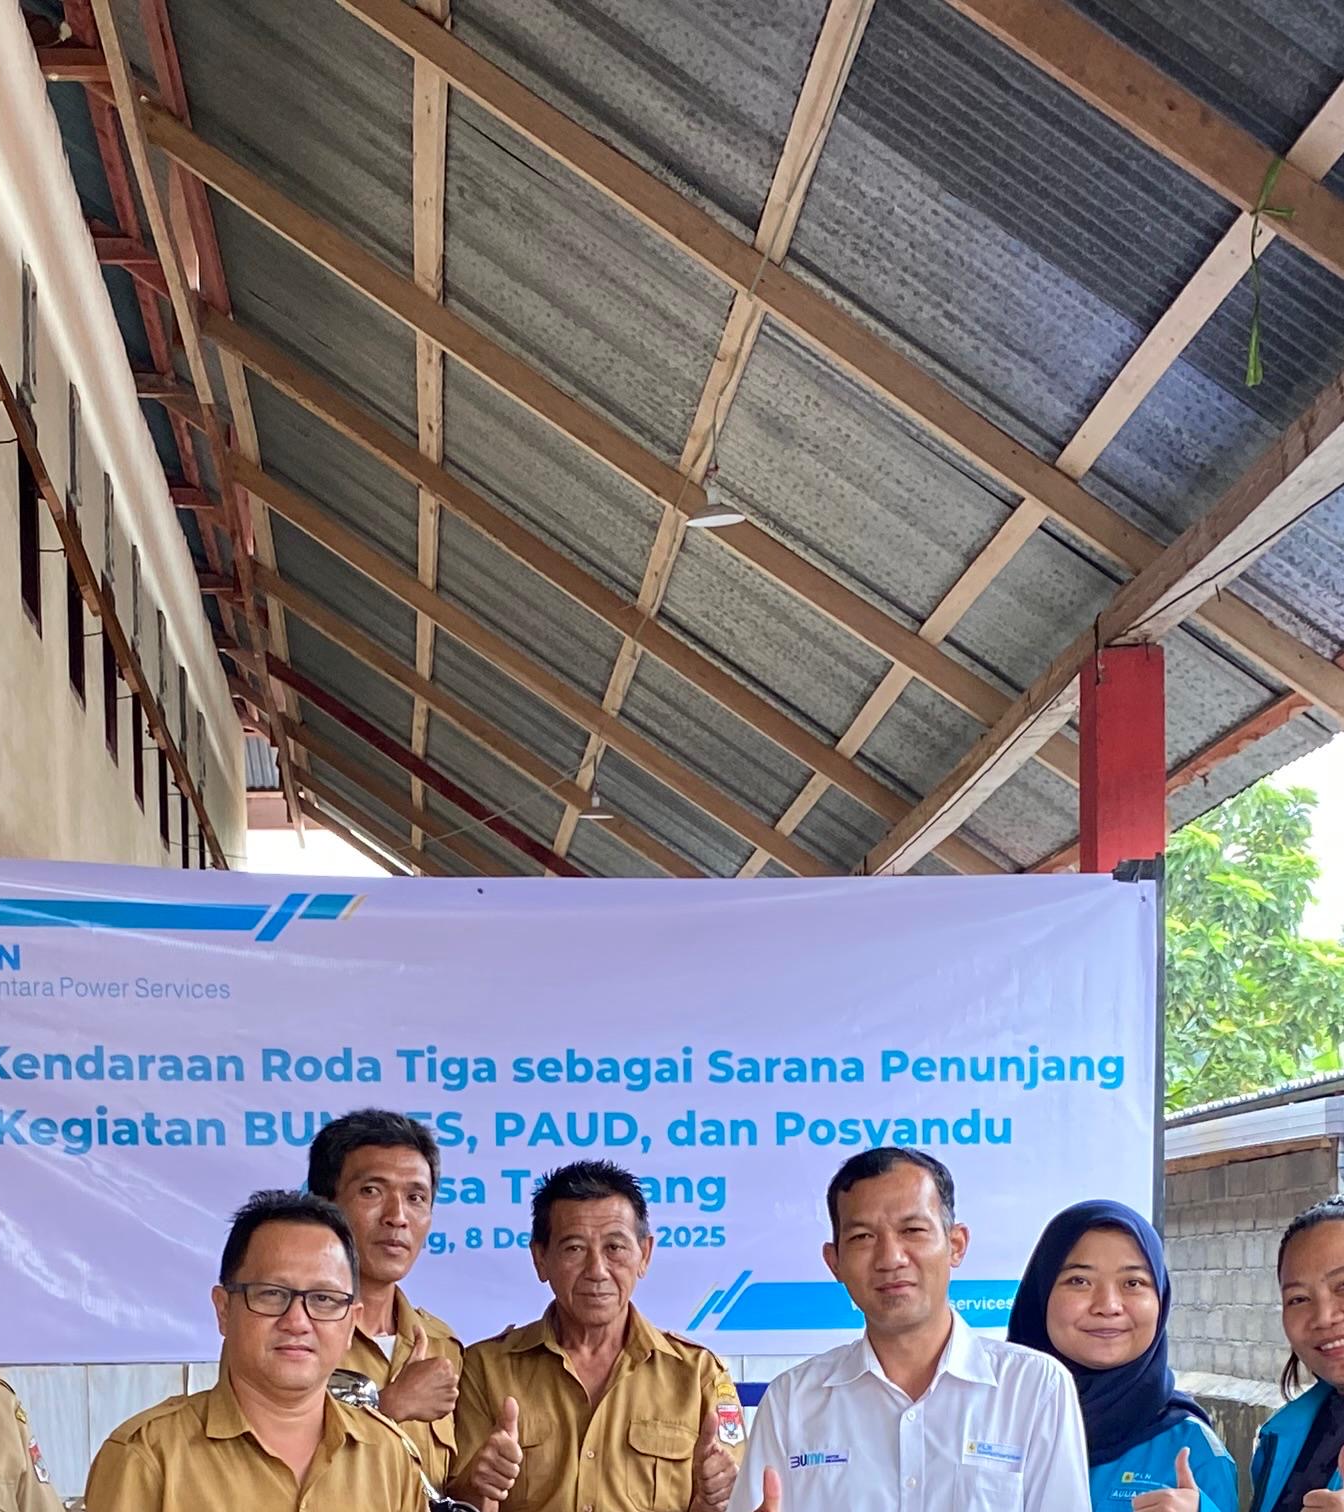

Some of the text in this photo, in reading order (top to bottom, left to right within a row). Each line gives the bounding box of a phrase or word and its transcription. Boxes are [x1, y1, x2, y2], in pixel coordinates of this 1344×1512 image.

[60, 977, 128, 998] Power
[135, 979, 231, 999] Services
[261, 1047, 382, 1082] Roda
[396, 1045, 496, 1092] Tiga
[512, 1046, 693, 1092] sebagai
[707, 1049, 864, 1084] Sarana
[880, 1045, 1125, 1090] Penunjang
[244, 1111, 478, 1154] BUS,
[495, 1111, 652, 1153] PAUD,
[666, 1109, 758, 1148] dan
[775, 1108, 1012, 1150] Posyandu
[464, 1226, 484, 1249] 8
[655, 1224, 727, 1248] 2025
